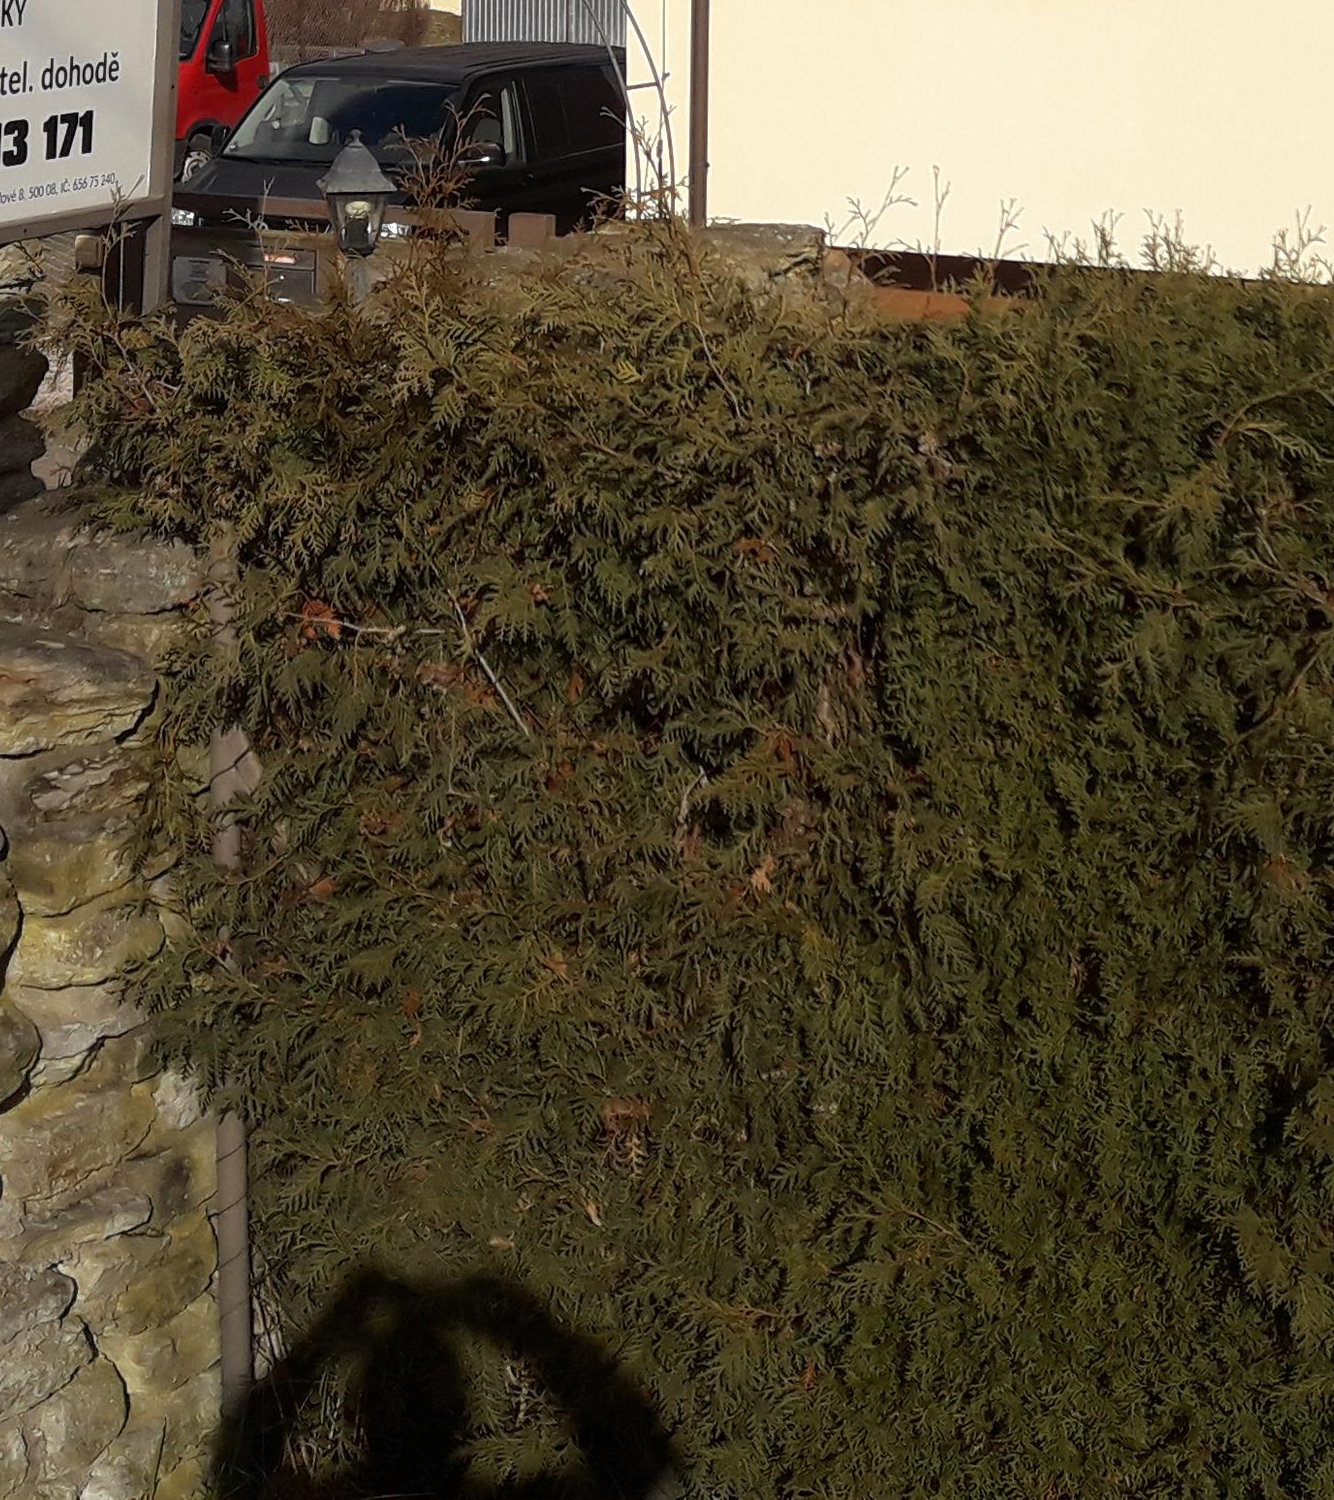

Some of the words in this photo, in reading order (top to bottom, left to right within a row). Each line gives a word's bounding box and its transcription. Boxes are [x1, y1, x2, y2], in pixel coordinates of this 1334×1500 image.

[0, 60, 33, 95] tel.
[40, 51, 120, 91] dohodě
[42, 110, 94, 161] 171
[28, 185, 45, 199] 500
